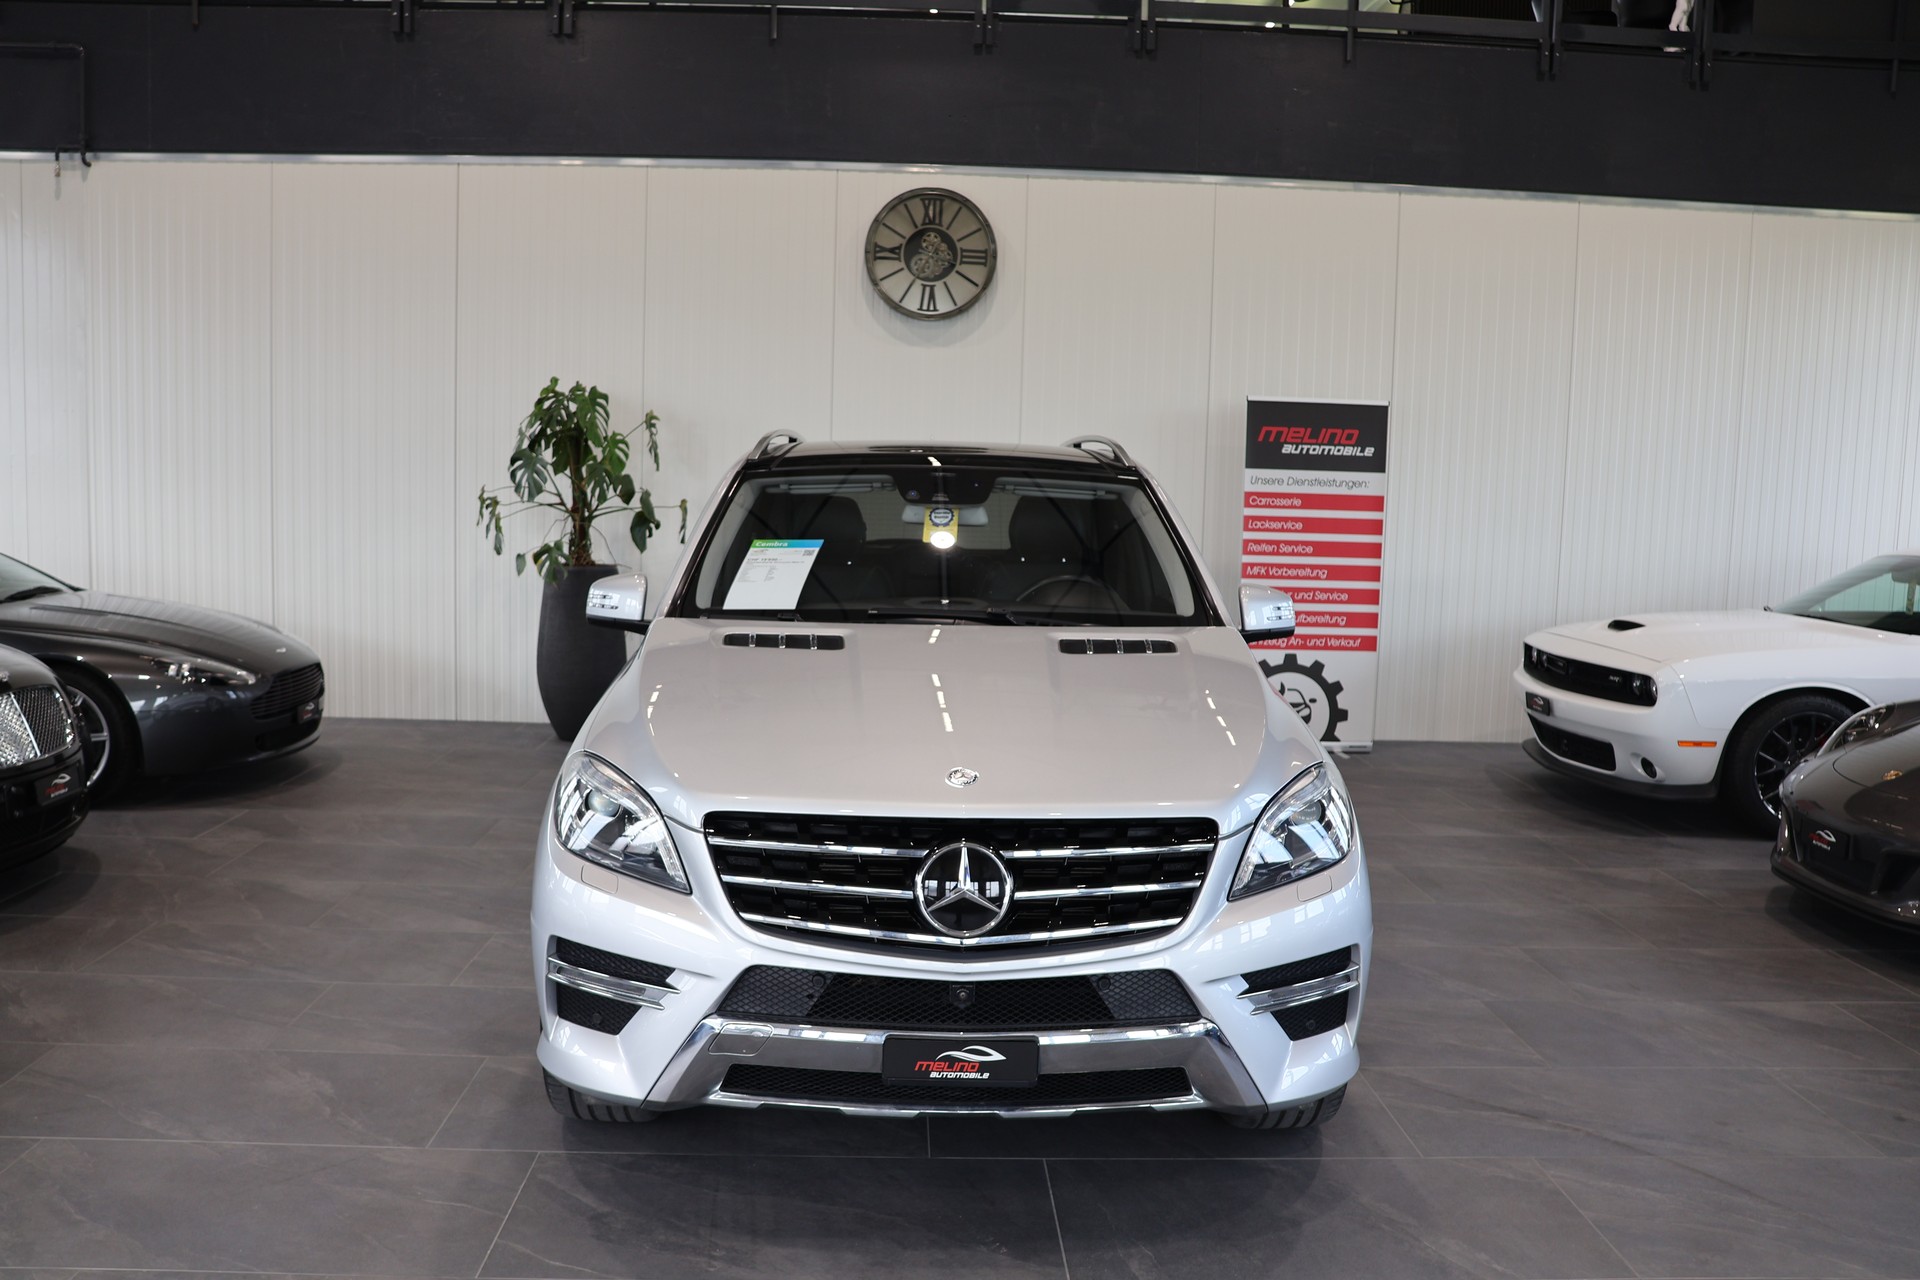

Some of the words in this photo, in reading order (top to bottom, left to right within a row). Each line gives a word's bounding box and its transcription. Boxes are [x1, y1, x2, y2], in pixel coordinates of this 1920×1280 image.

[1250, 475, 1285, 486] Unsere
[1286, 476, 1370, 490] Dienstleistungen:
[1249, 495, 1302, 507] Carrosserie
[1248, 519, 1303, 531] Lackservice
[1247, 542, 1277, 553] Reifen
[1279, 543, 1313, 554] Service
[1246, 566, 1267, 577] MFK
[1269, 567, 1328, 579] Vorbereitung
[1294, 592, 1313, 600] und
[1314, 591, 1348, 601] Service
[1294, 614, 1347, 626] ufbereitung
[1288, 637, 1304, 647] An-
[1307, 638, 1326, 647] und
[1327, 638, 1361, 648] Verkauf
